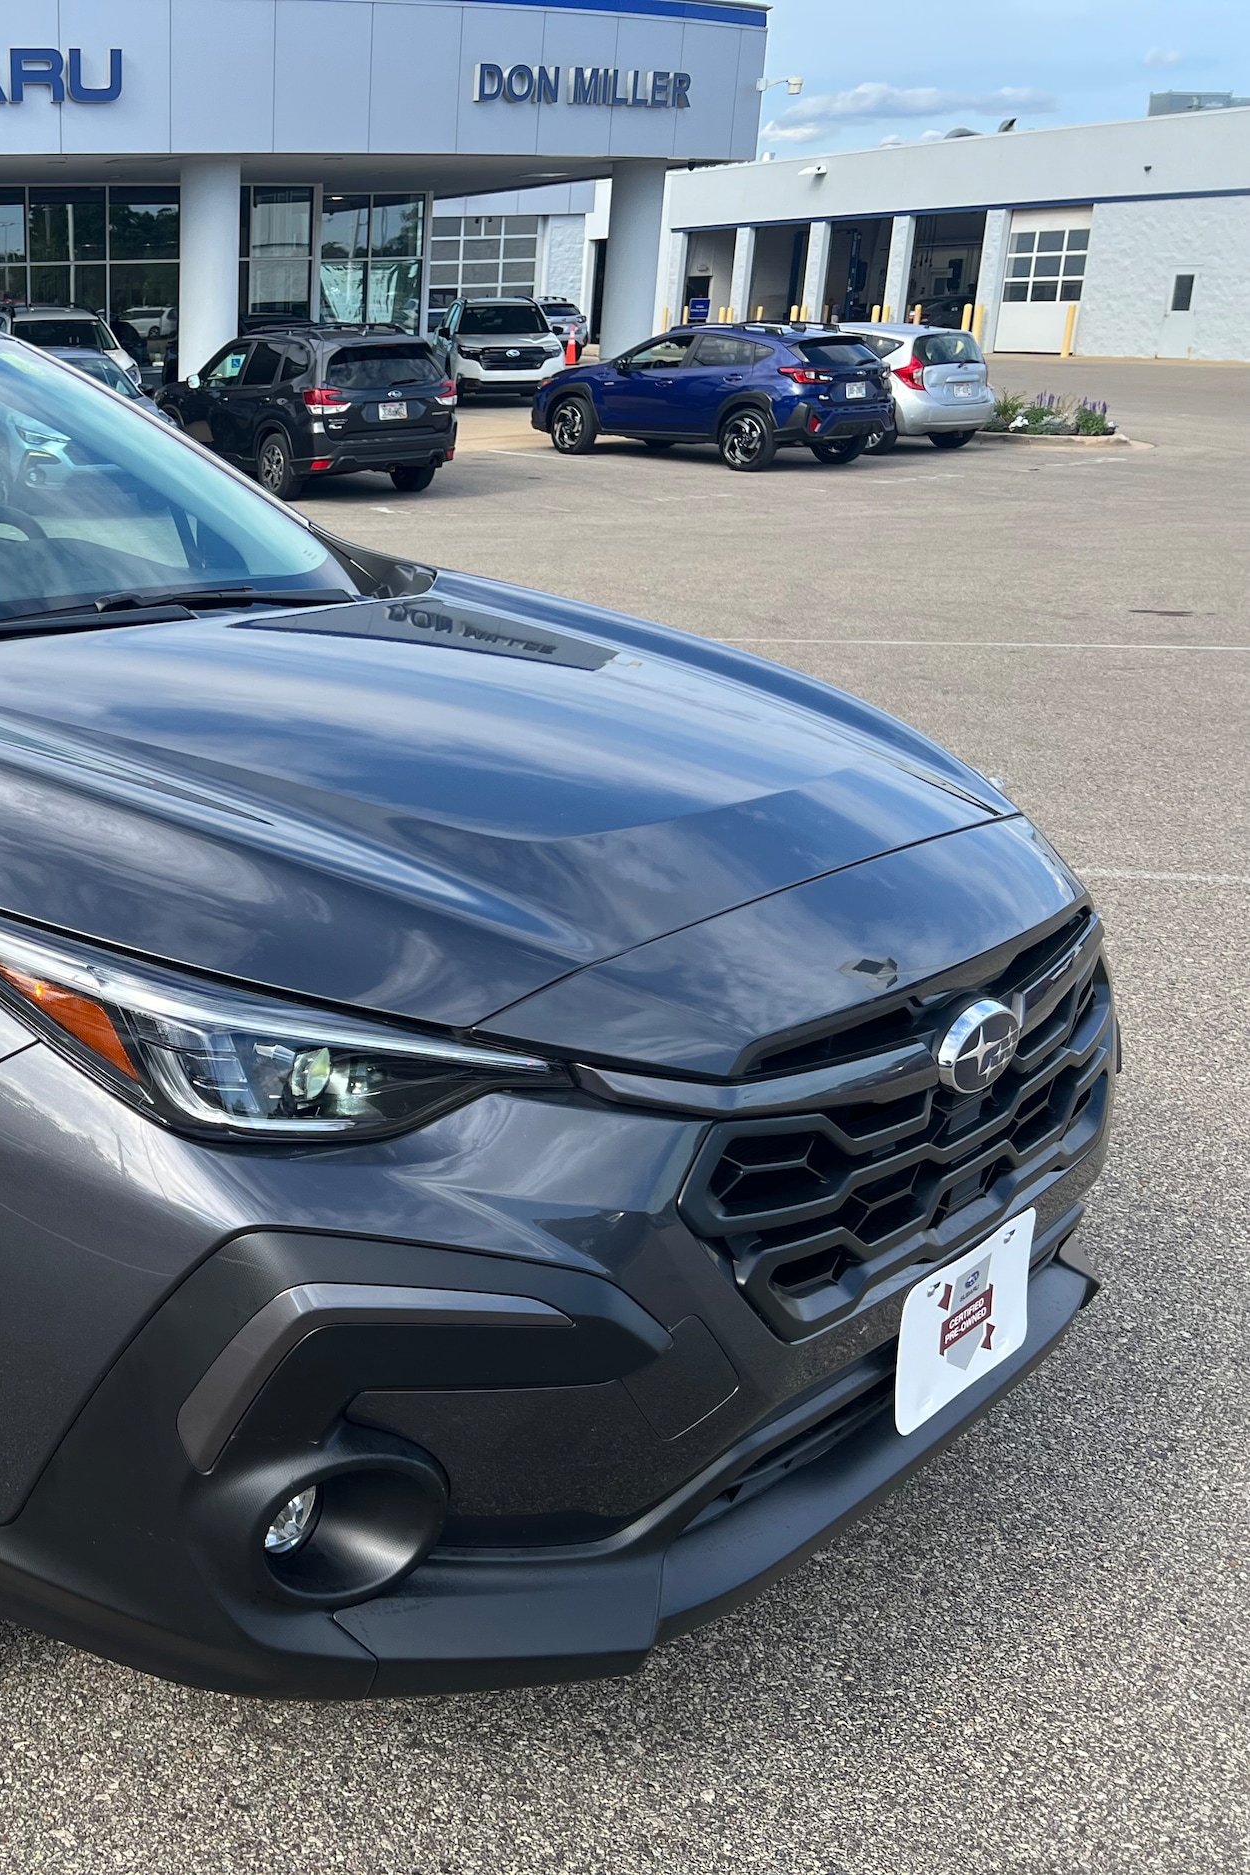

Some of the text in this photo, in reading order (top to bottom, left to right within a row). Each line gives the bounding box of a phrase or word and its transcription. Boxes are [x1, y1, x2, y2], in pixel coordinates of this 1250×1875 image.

[473, 62, 692, 108] DON MILLER
[960, 1286, 979, 1302] SUBARU
[944, 1306, 987, 1345] PRE-OWNED
[949, 1298, 984, 1329] CERTIFIED
